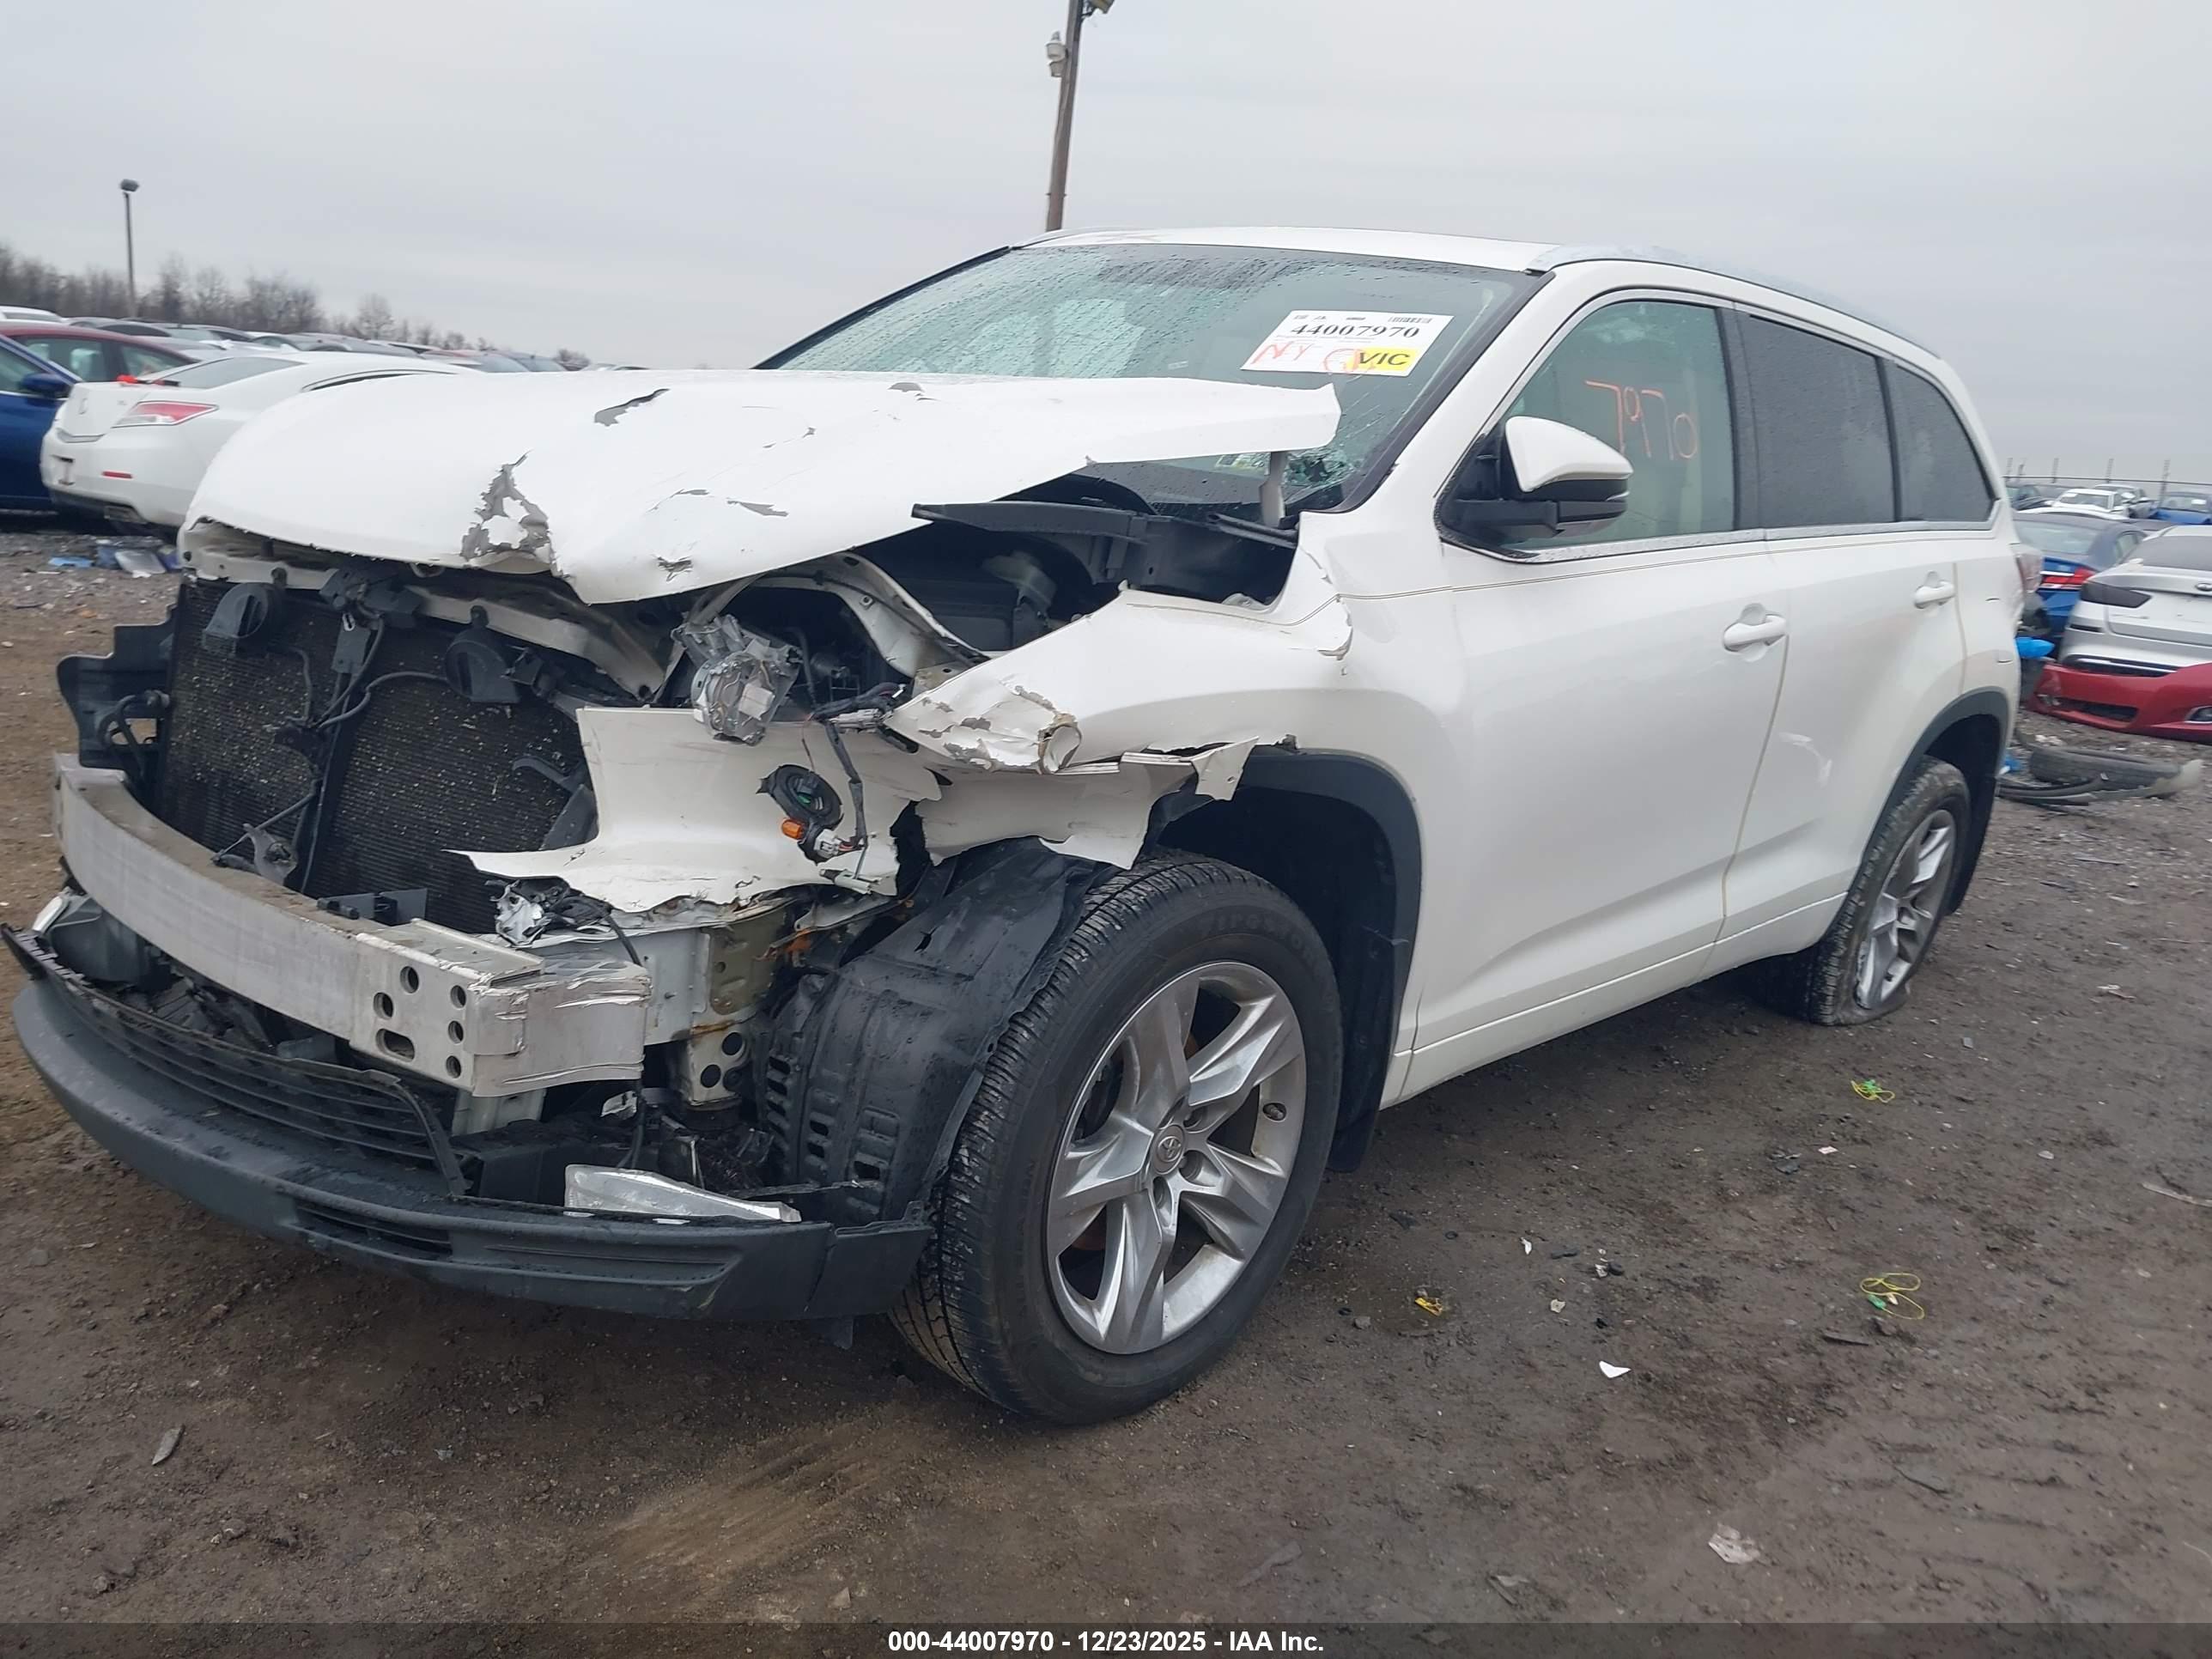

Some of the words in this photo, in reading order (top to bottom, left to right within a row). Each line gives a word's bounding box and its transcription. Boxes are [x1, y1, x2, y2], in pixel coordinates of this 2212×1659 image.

[1291, 324, 1420, 338] 44007970
[1359, 352, 1411, 366] VIC
[1584, 380, 1698, 461] 7970
